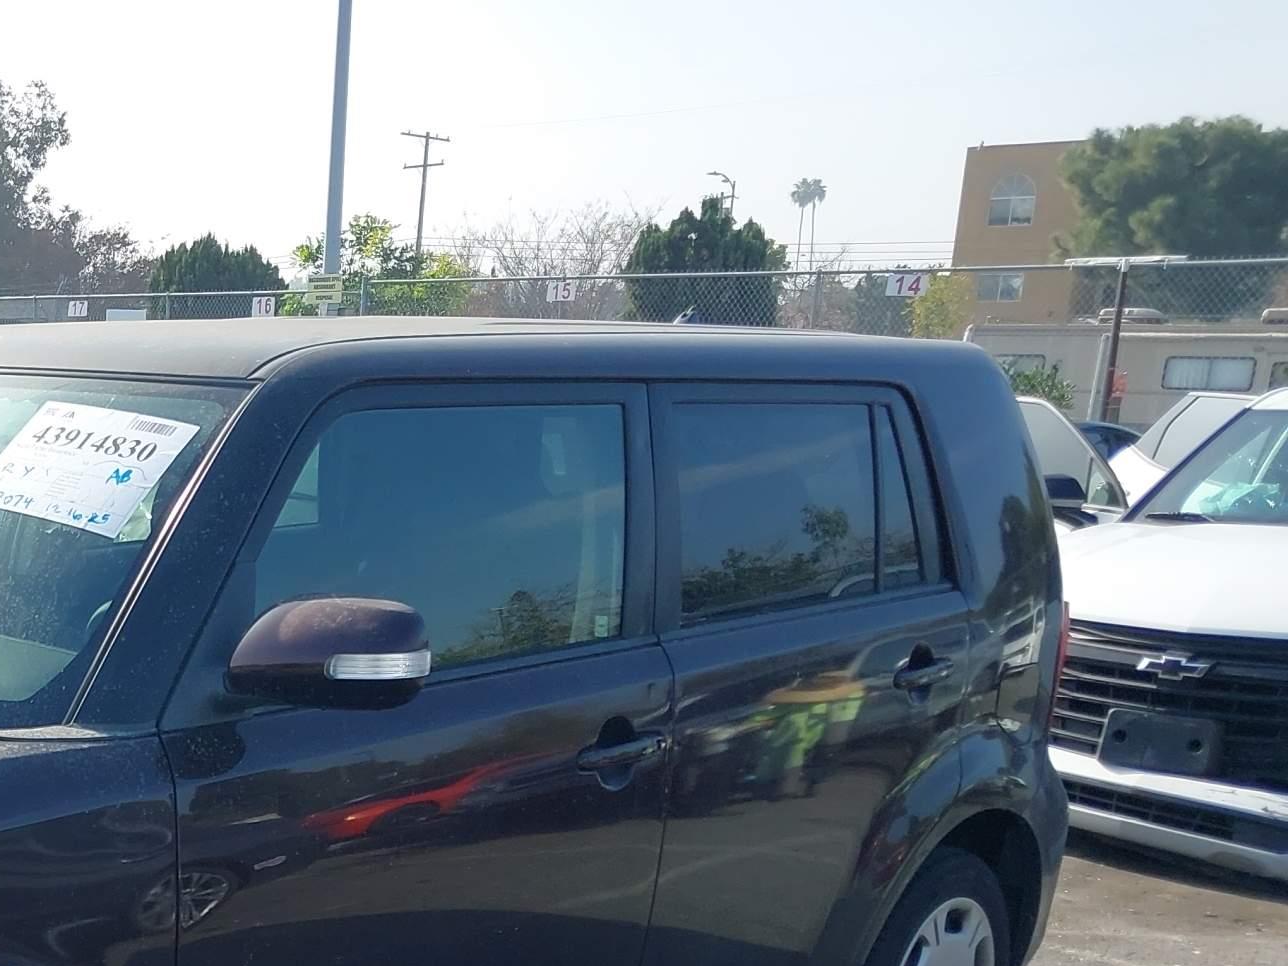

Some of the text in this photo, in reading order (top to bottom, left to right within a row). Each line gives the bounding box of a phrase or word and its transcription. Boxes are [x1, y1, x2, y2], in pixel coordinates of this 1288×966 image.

[552, 282, 571, 300] 15
[895, 275, 921, 295] 14
[70, 300, 85, 315] 17
[255, 297, 272, 314] 16
[32, 425, 158, 462] 43914830
